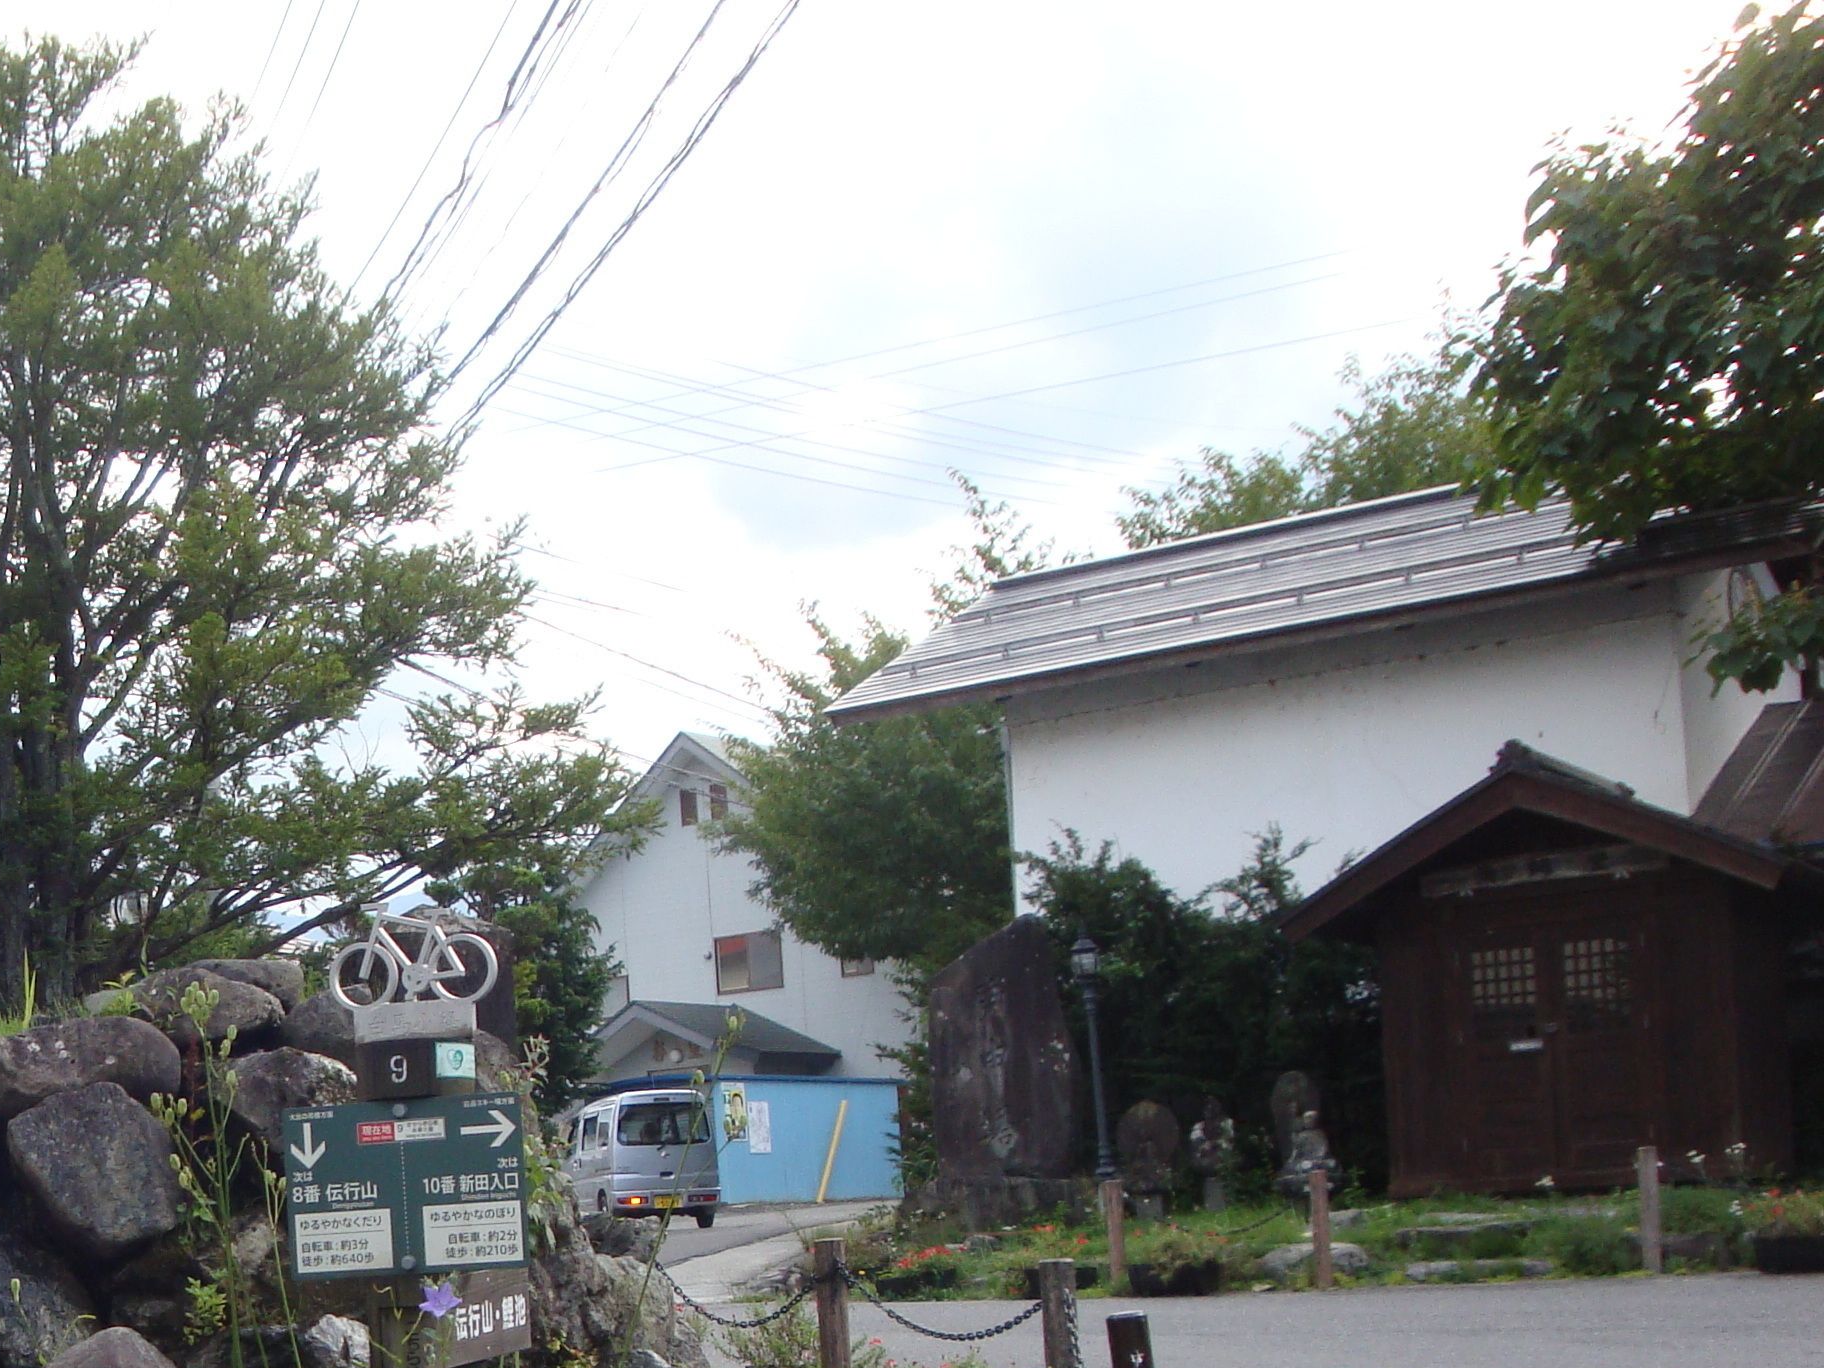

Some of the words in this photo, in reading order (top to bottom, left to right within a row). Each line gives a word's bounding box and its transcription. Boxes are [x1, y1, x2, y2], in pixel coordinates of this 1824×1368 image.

[390, 1055, 407, 1083] 9
[496, 1157, 519, 1168] 次は
[292, 1171, 313, 1183] 次は
[423, 1175, 456, 1194] 10番
[459, 1172, 519, 1193] 新田入口
[292, 1184, 321, 1203] 8番
[325, 1181, 378, 1201] 伝行山
[430, 1207, 516, 1222] ゆるやかなのぼり
[300, 1216, 382, 1231] ゆるやかなくだり
